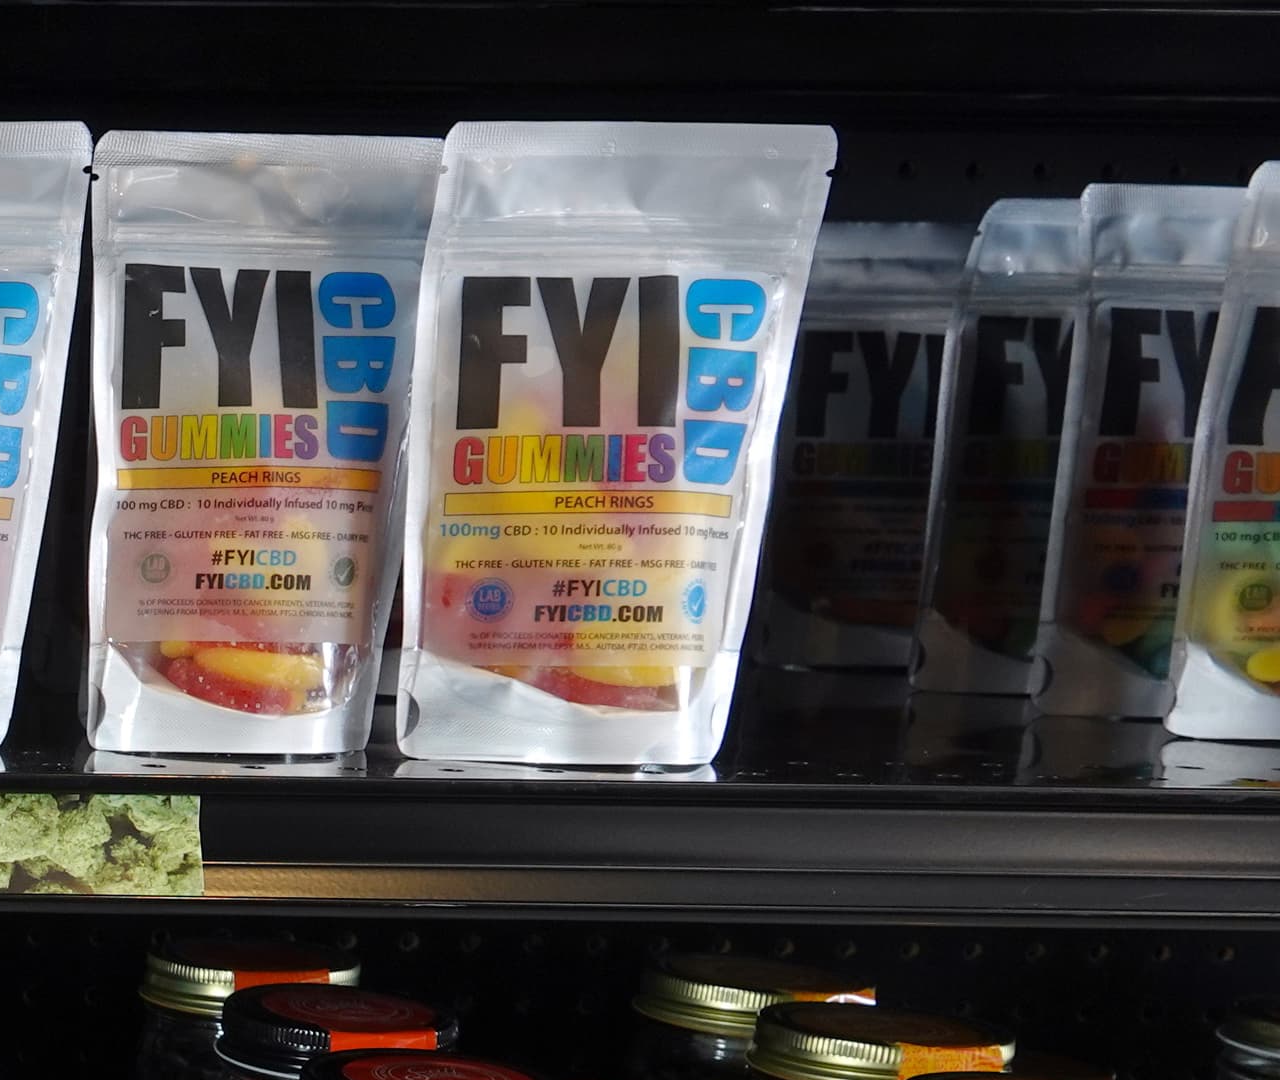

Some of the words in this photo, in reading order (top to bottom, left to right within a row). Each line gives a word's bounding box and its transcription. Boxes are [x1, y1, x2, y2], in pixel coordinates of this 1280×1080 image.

[120, 263, 319, 413] FYI
[454, 275, 680, 431] FYI
[682, 277, 768, 487] CBD
[451, 433, 676, 487] GUMMIES
